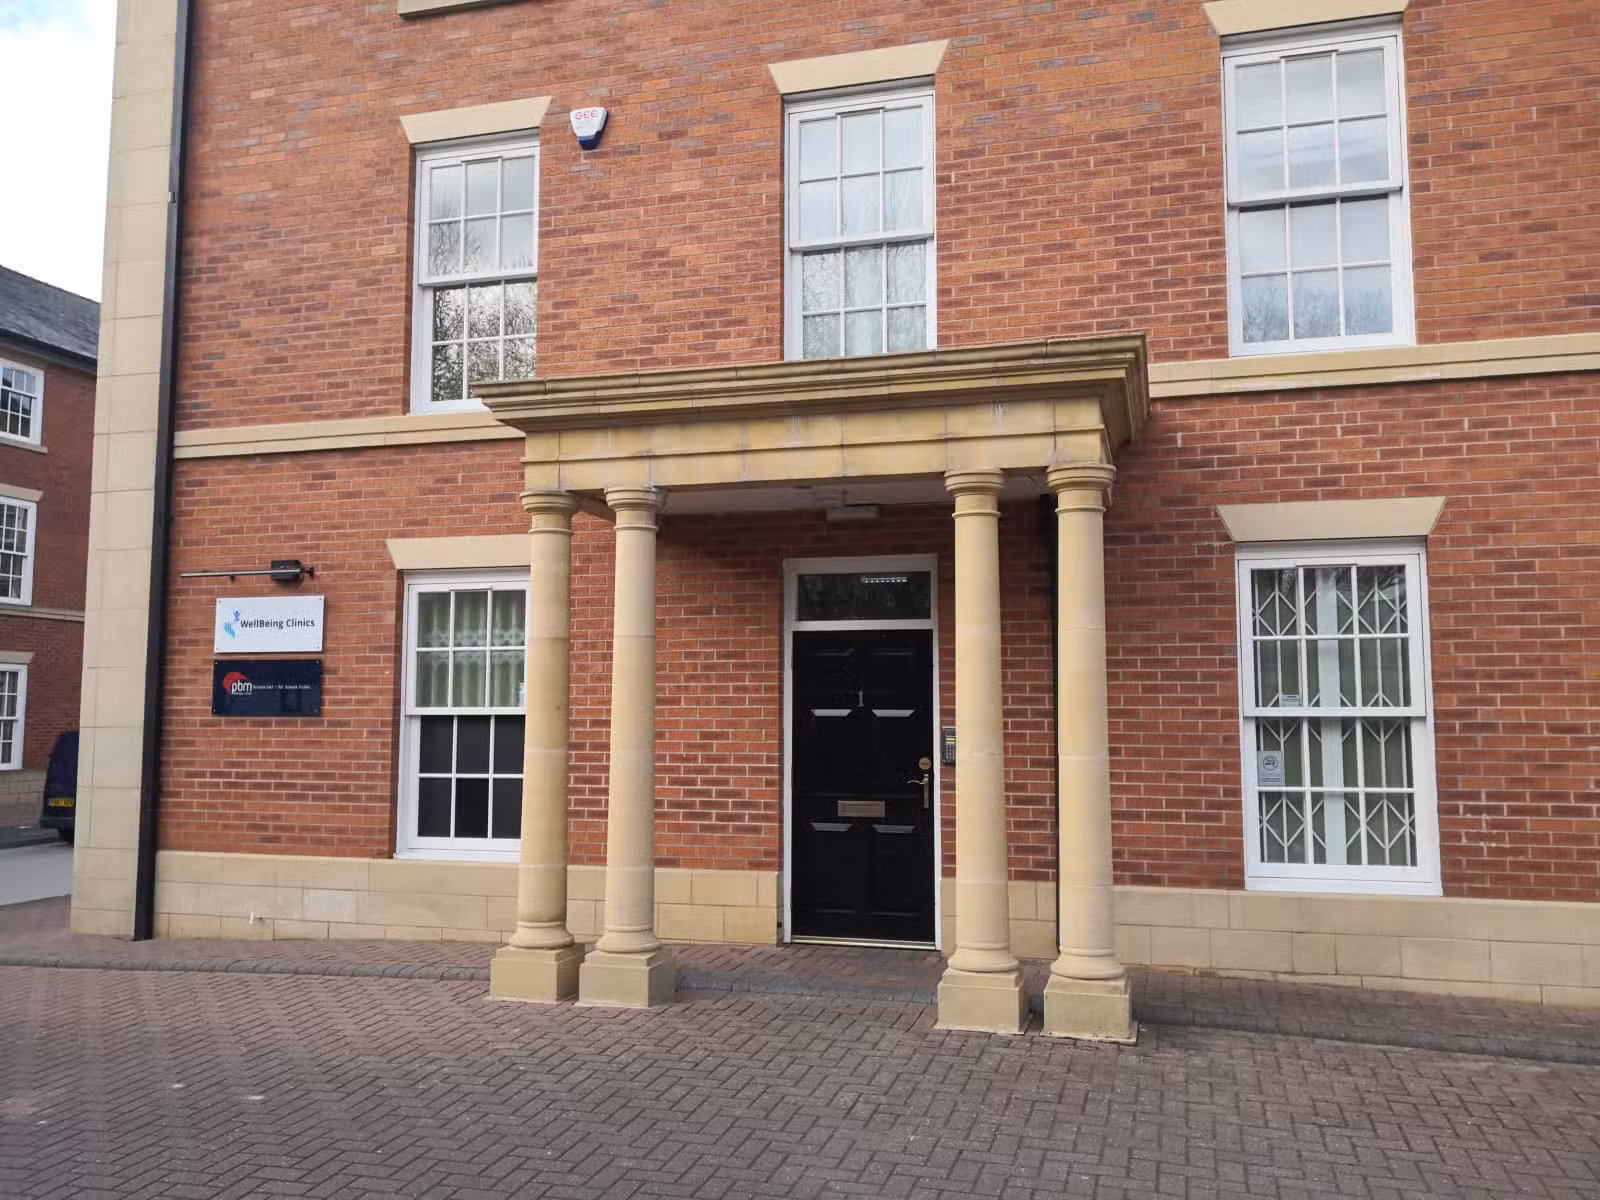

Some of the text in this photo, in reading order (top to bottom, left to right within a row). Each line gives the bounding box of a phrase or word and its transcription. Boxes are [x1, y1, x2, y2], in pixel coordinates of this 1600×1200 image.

[240, 618, 315, 630] WellBeing Clinics
[231, 680, 253, 695] pbm
